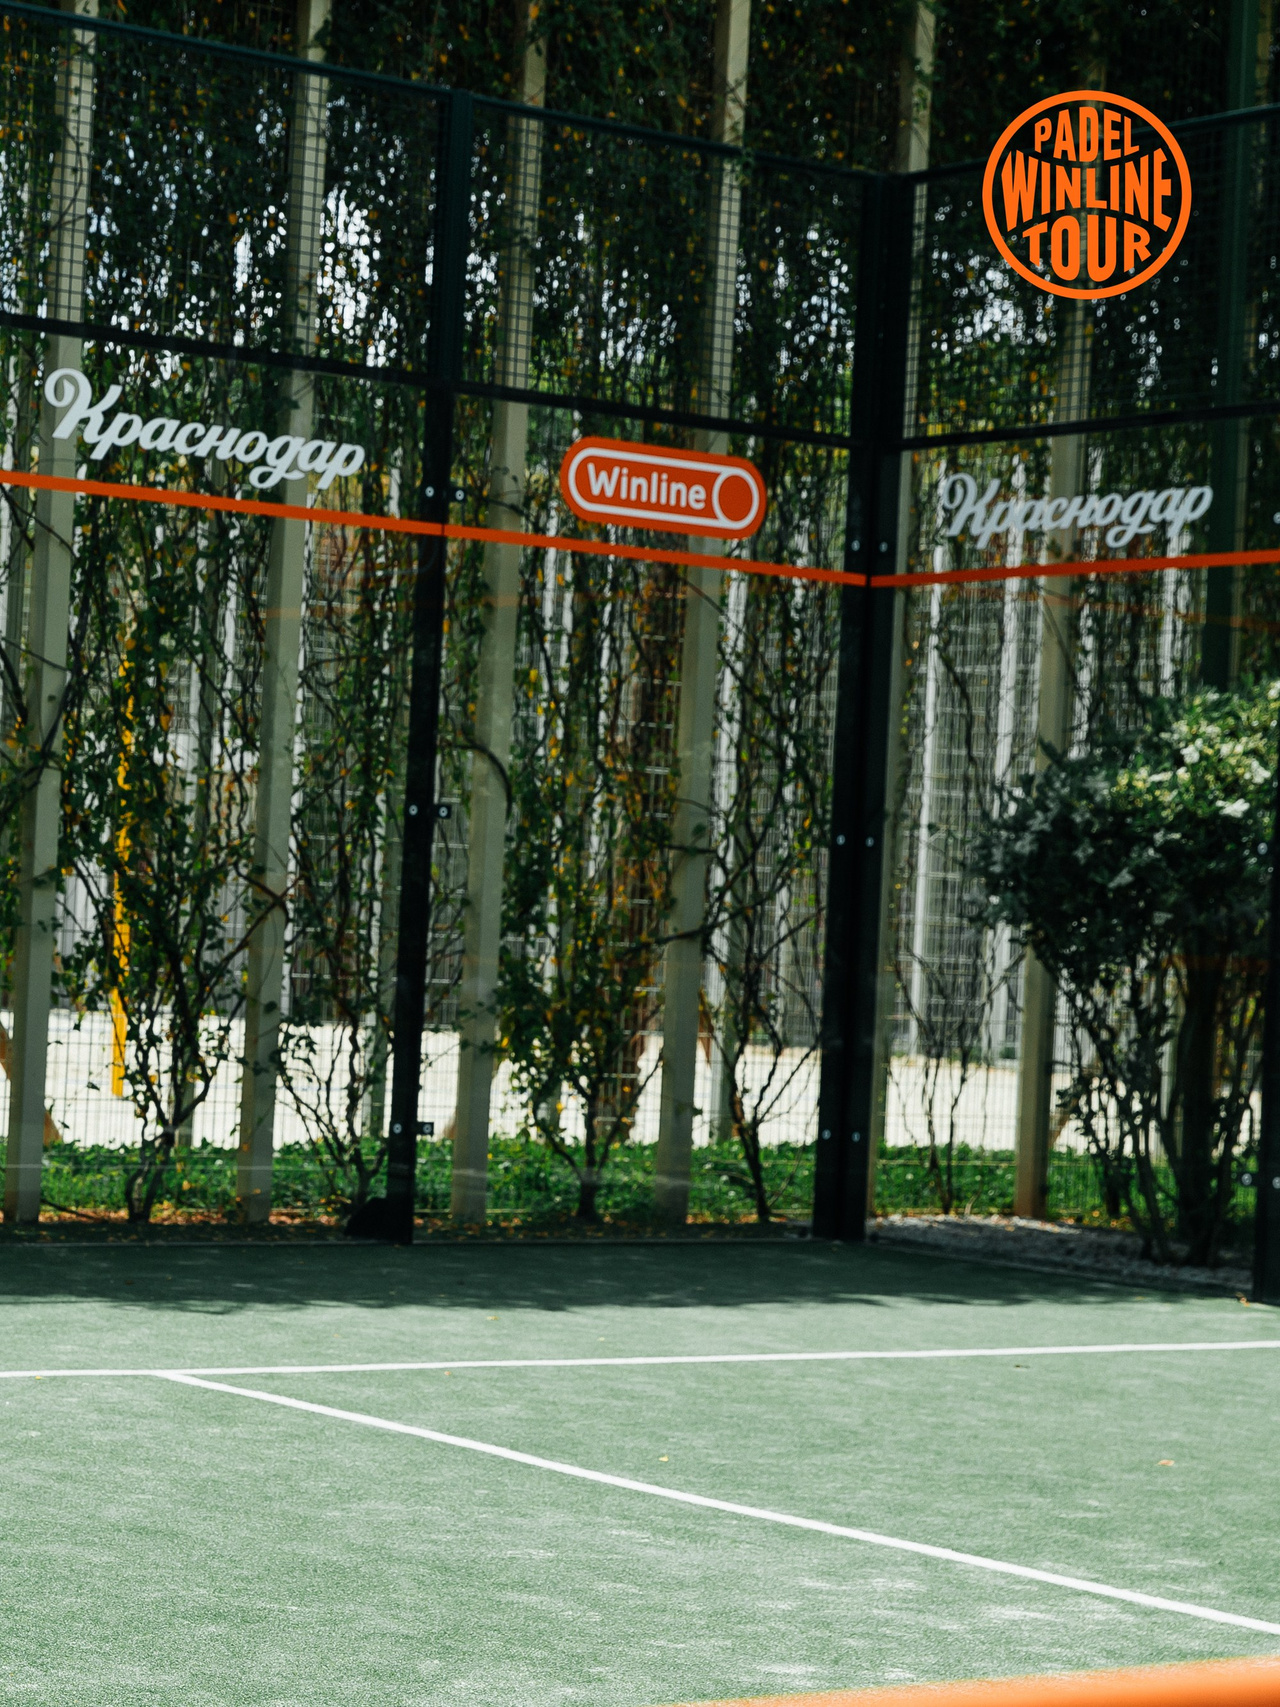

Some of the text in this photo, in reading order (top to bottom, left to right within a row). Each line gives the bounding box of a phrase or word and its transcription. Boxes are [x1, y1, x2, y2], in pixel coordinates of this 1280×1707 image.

[44, 368, 365, 489] Краснодар
[586, 462, 707, 510] Winline
[942, 472, 1214, 549] Краснодар
